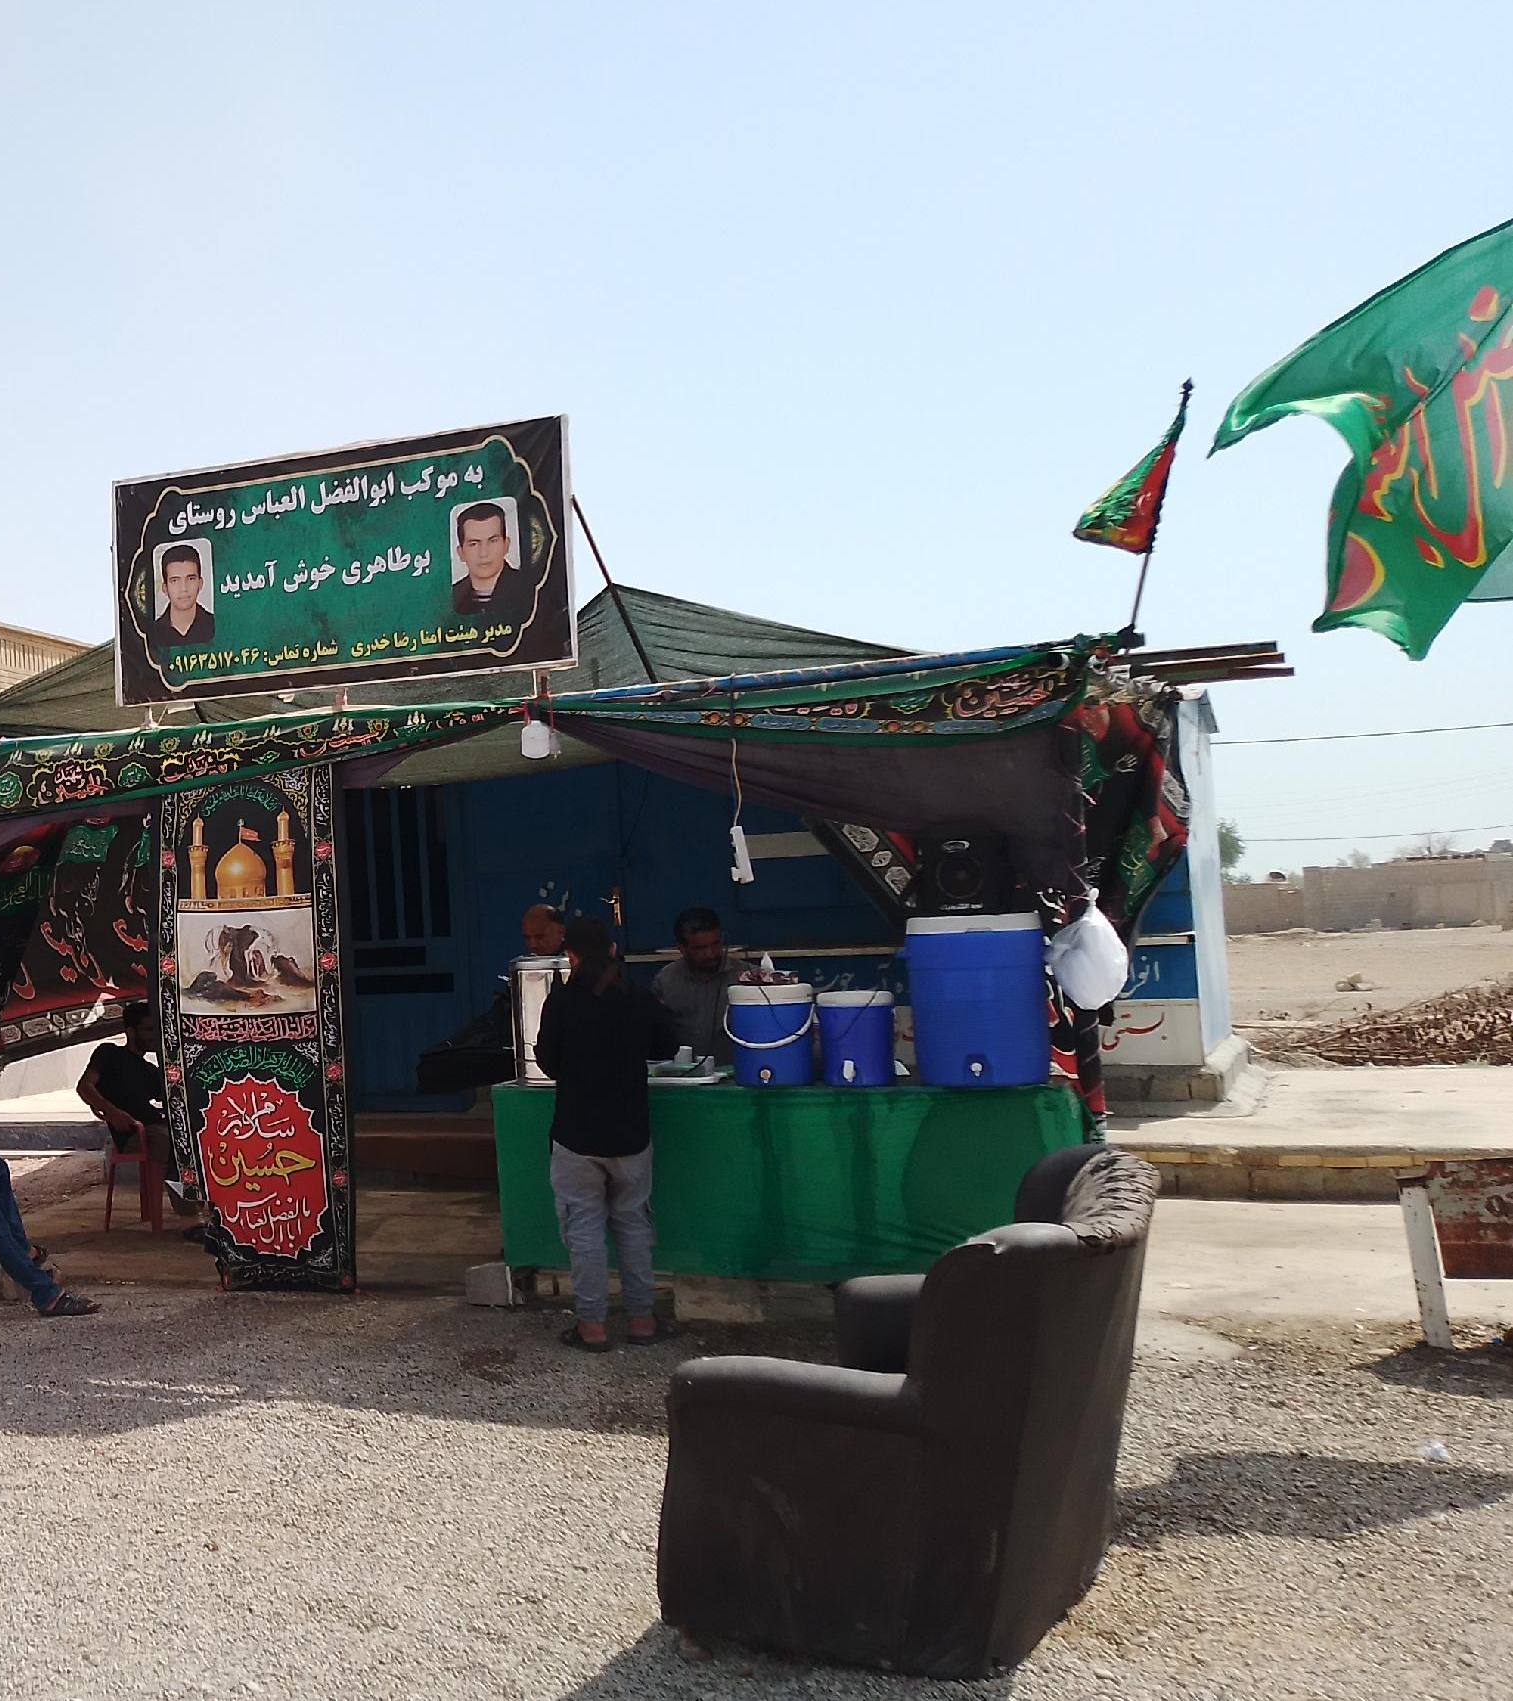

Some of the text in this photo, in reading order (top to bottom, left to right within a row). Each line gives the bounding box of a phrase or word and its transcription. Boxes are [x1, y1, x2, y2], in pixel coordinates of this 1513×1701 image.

[168, 463, 484, 534] به موکب ابوالفضل العباس روستای
[220, 545, 431, 599] بوطاهری خوش آمدید
[393, 632, 417, 652] رضا
[444, 624, 479, 644] هیئت
[481, 622, 513, 644] مدیر
[302, 638, 339, 663] شماره
[1118, 956, 1160, 998] انوا
